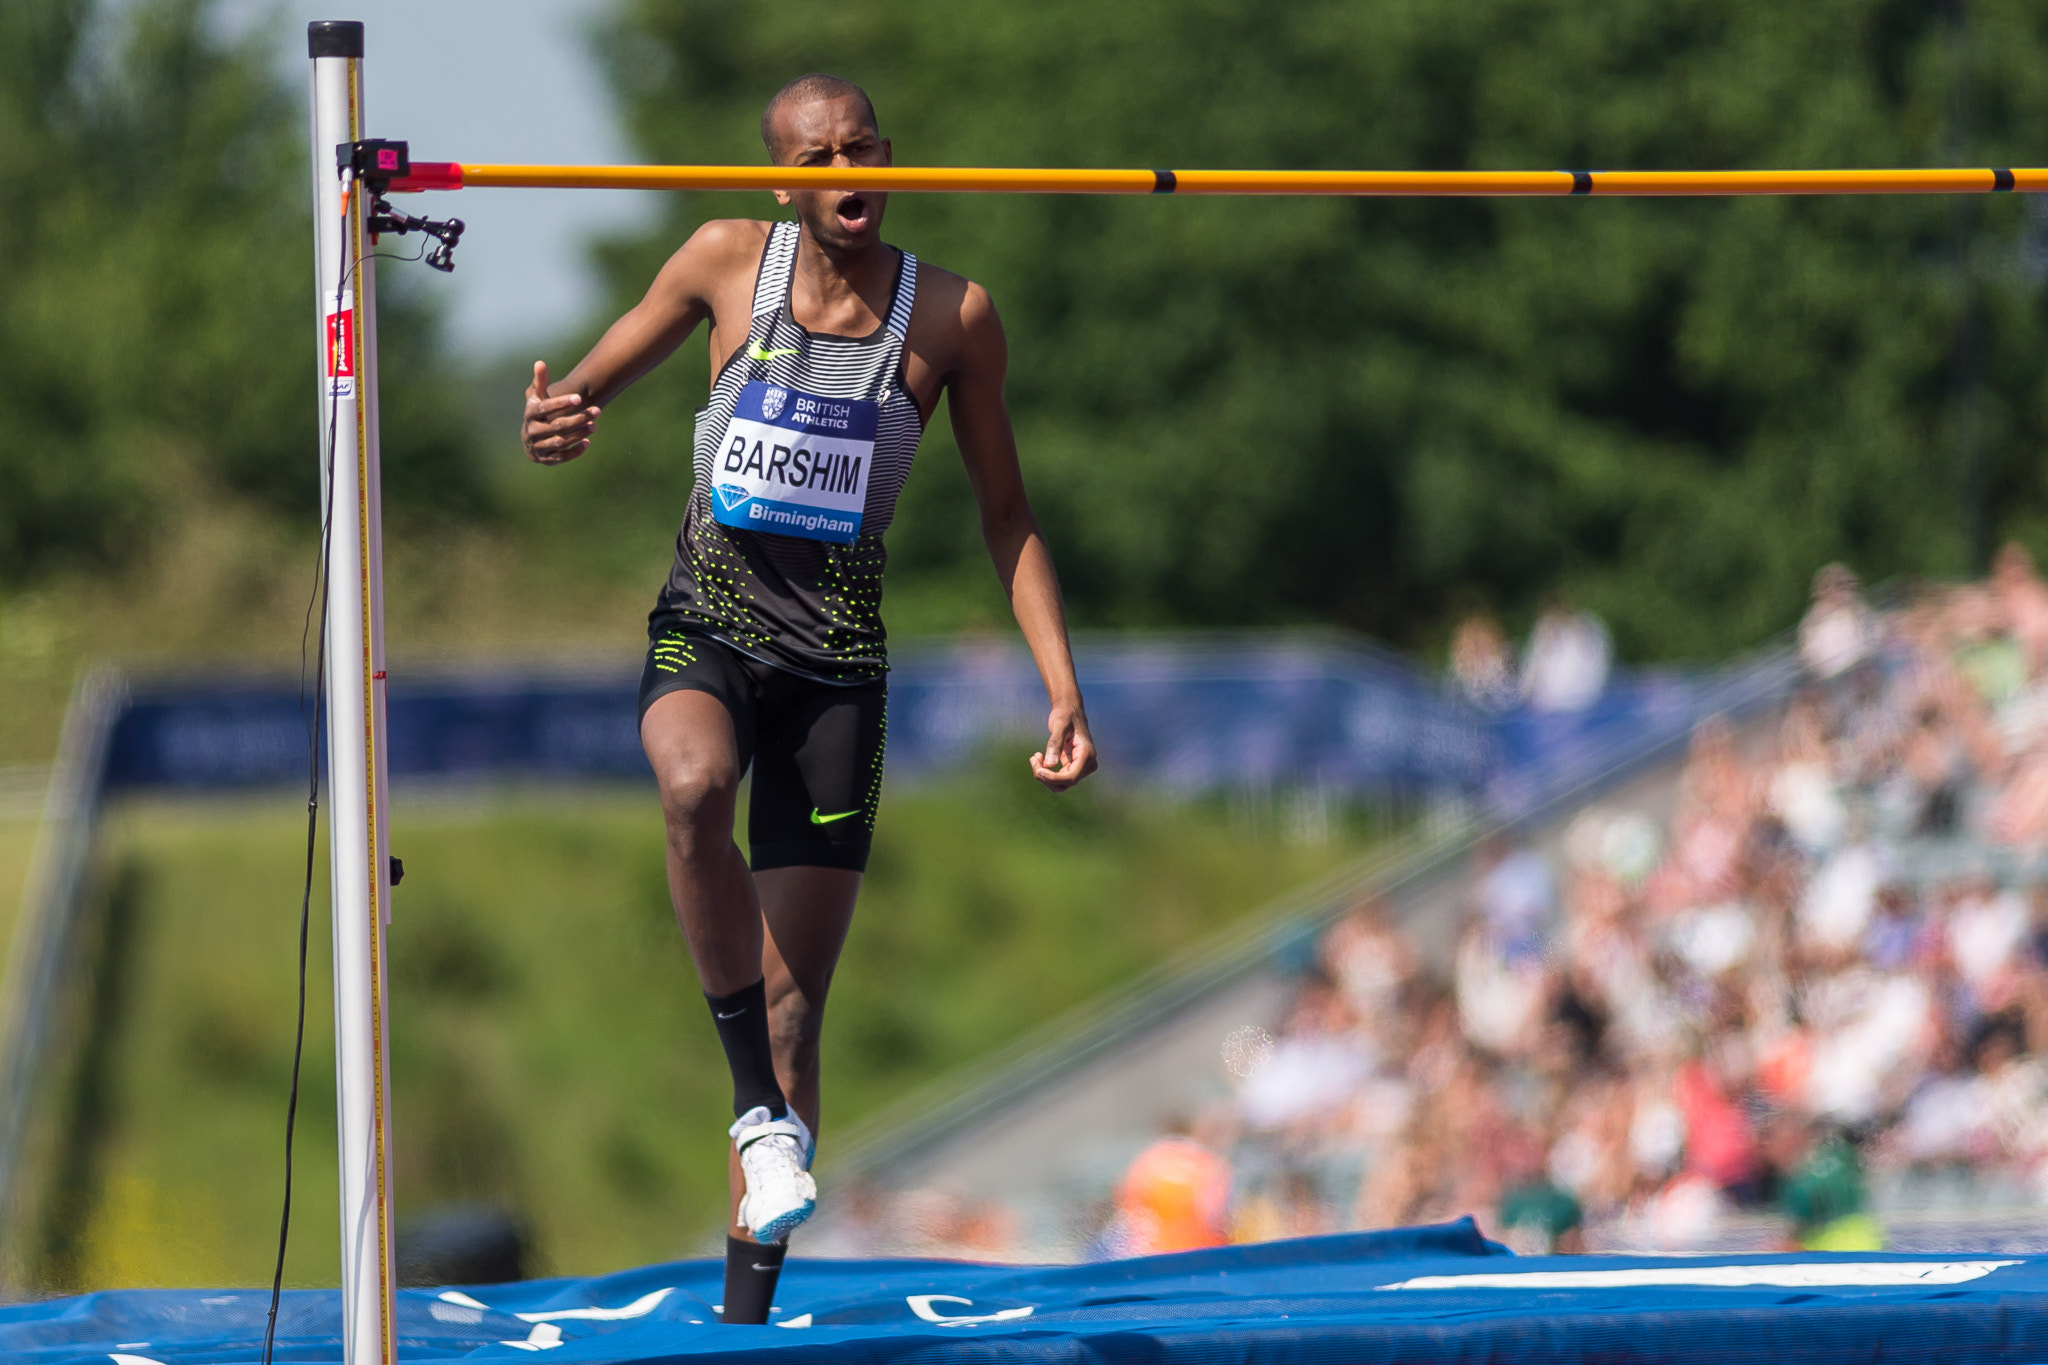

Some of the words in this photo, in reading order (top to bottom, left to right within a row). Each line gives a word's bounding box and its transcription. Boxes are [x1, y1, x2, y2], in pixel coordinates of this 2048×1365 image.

[791, 412, 849, 429] ATHLETICS
[796, 398, 850, 418] BRITISH
[724, 435, 862, 495] BARSHIM
[749, 503, 854, 534] Birmingham
